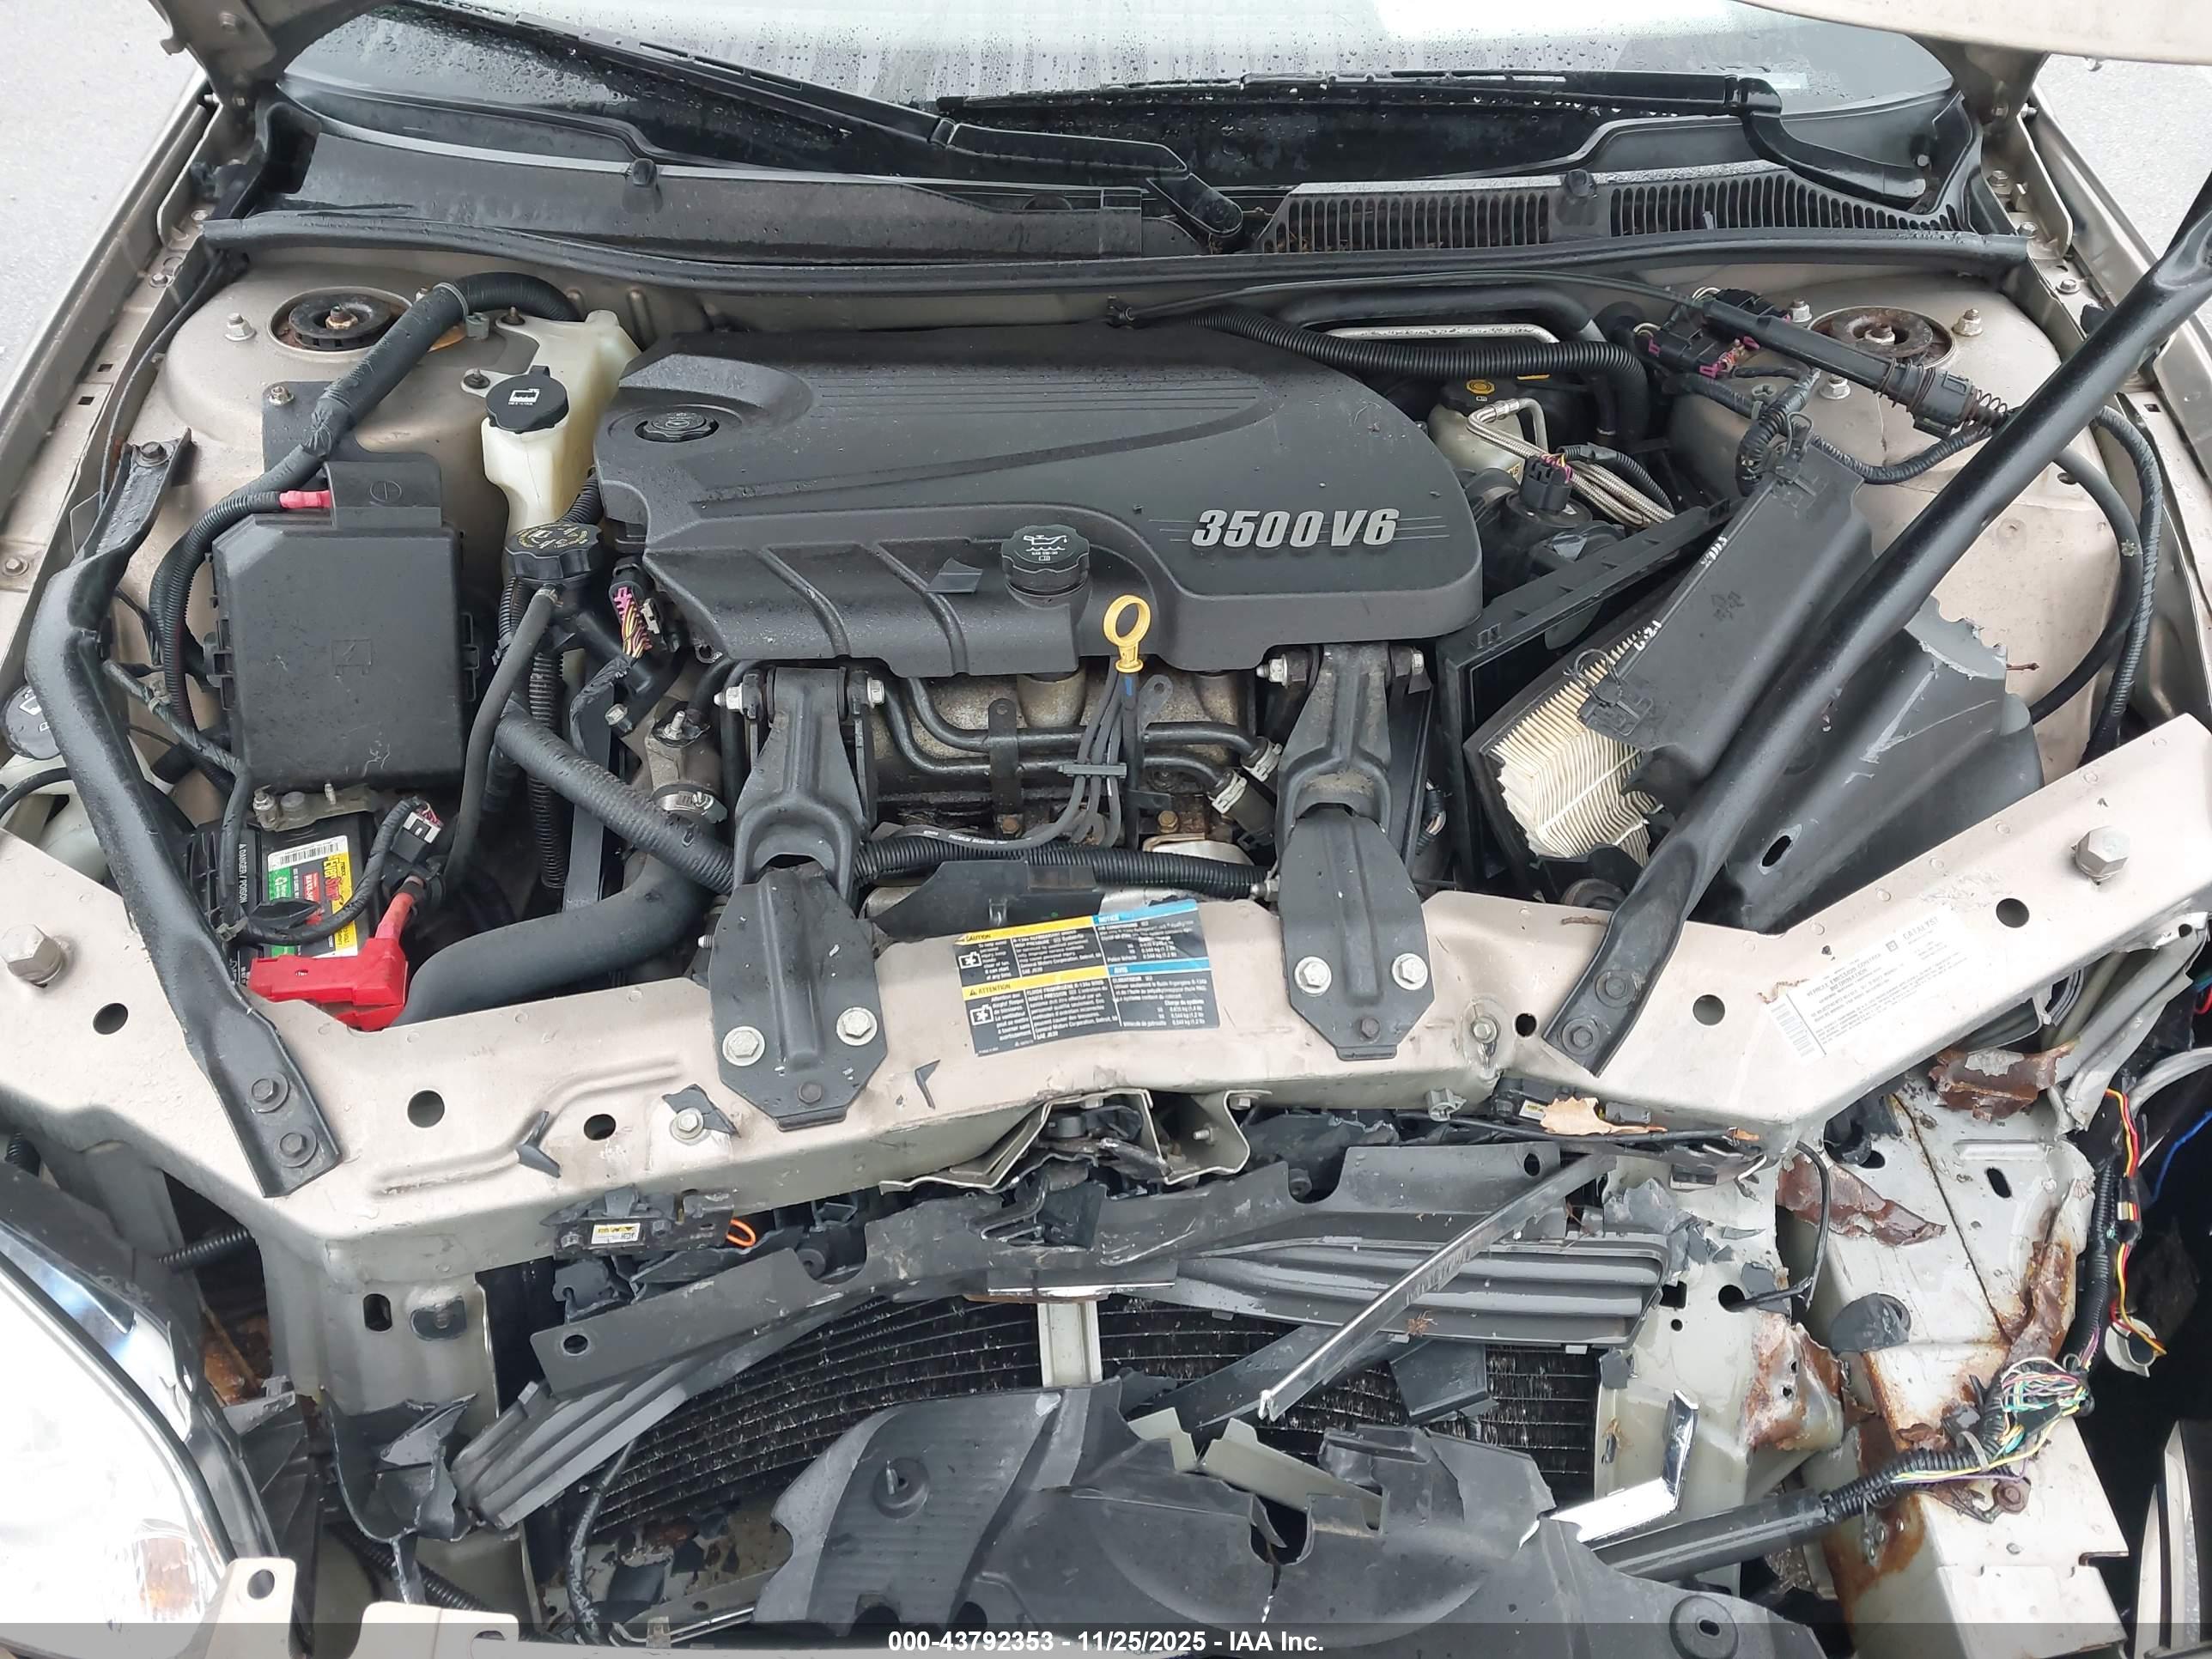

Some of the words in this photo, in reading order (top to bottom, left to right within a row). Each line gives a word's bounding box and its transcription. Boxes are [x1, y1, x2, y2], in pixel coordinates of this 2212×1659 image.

[1191, 508, 1325, 548] 3500
[1330, 508, 1400, 548] V6
[238, 848, 247, 874] DANGER
[239, 878, 248, 903] POISON
[1902, 915, 1939, 940] CATALYST
[977, 983, 1011, 994] ATTENTION
